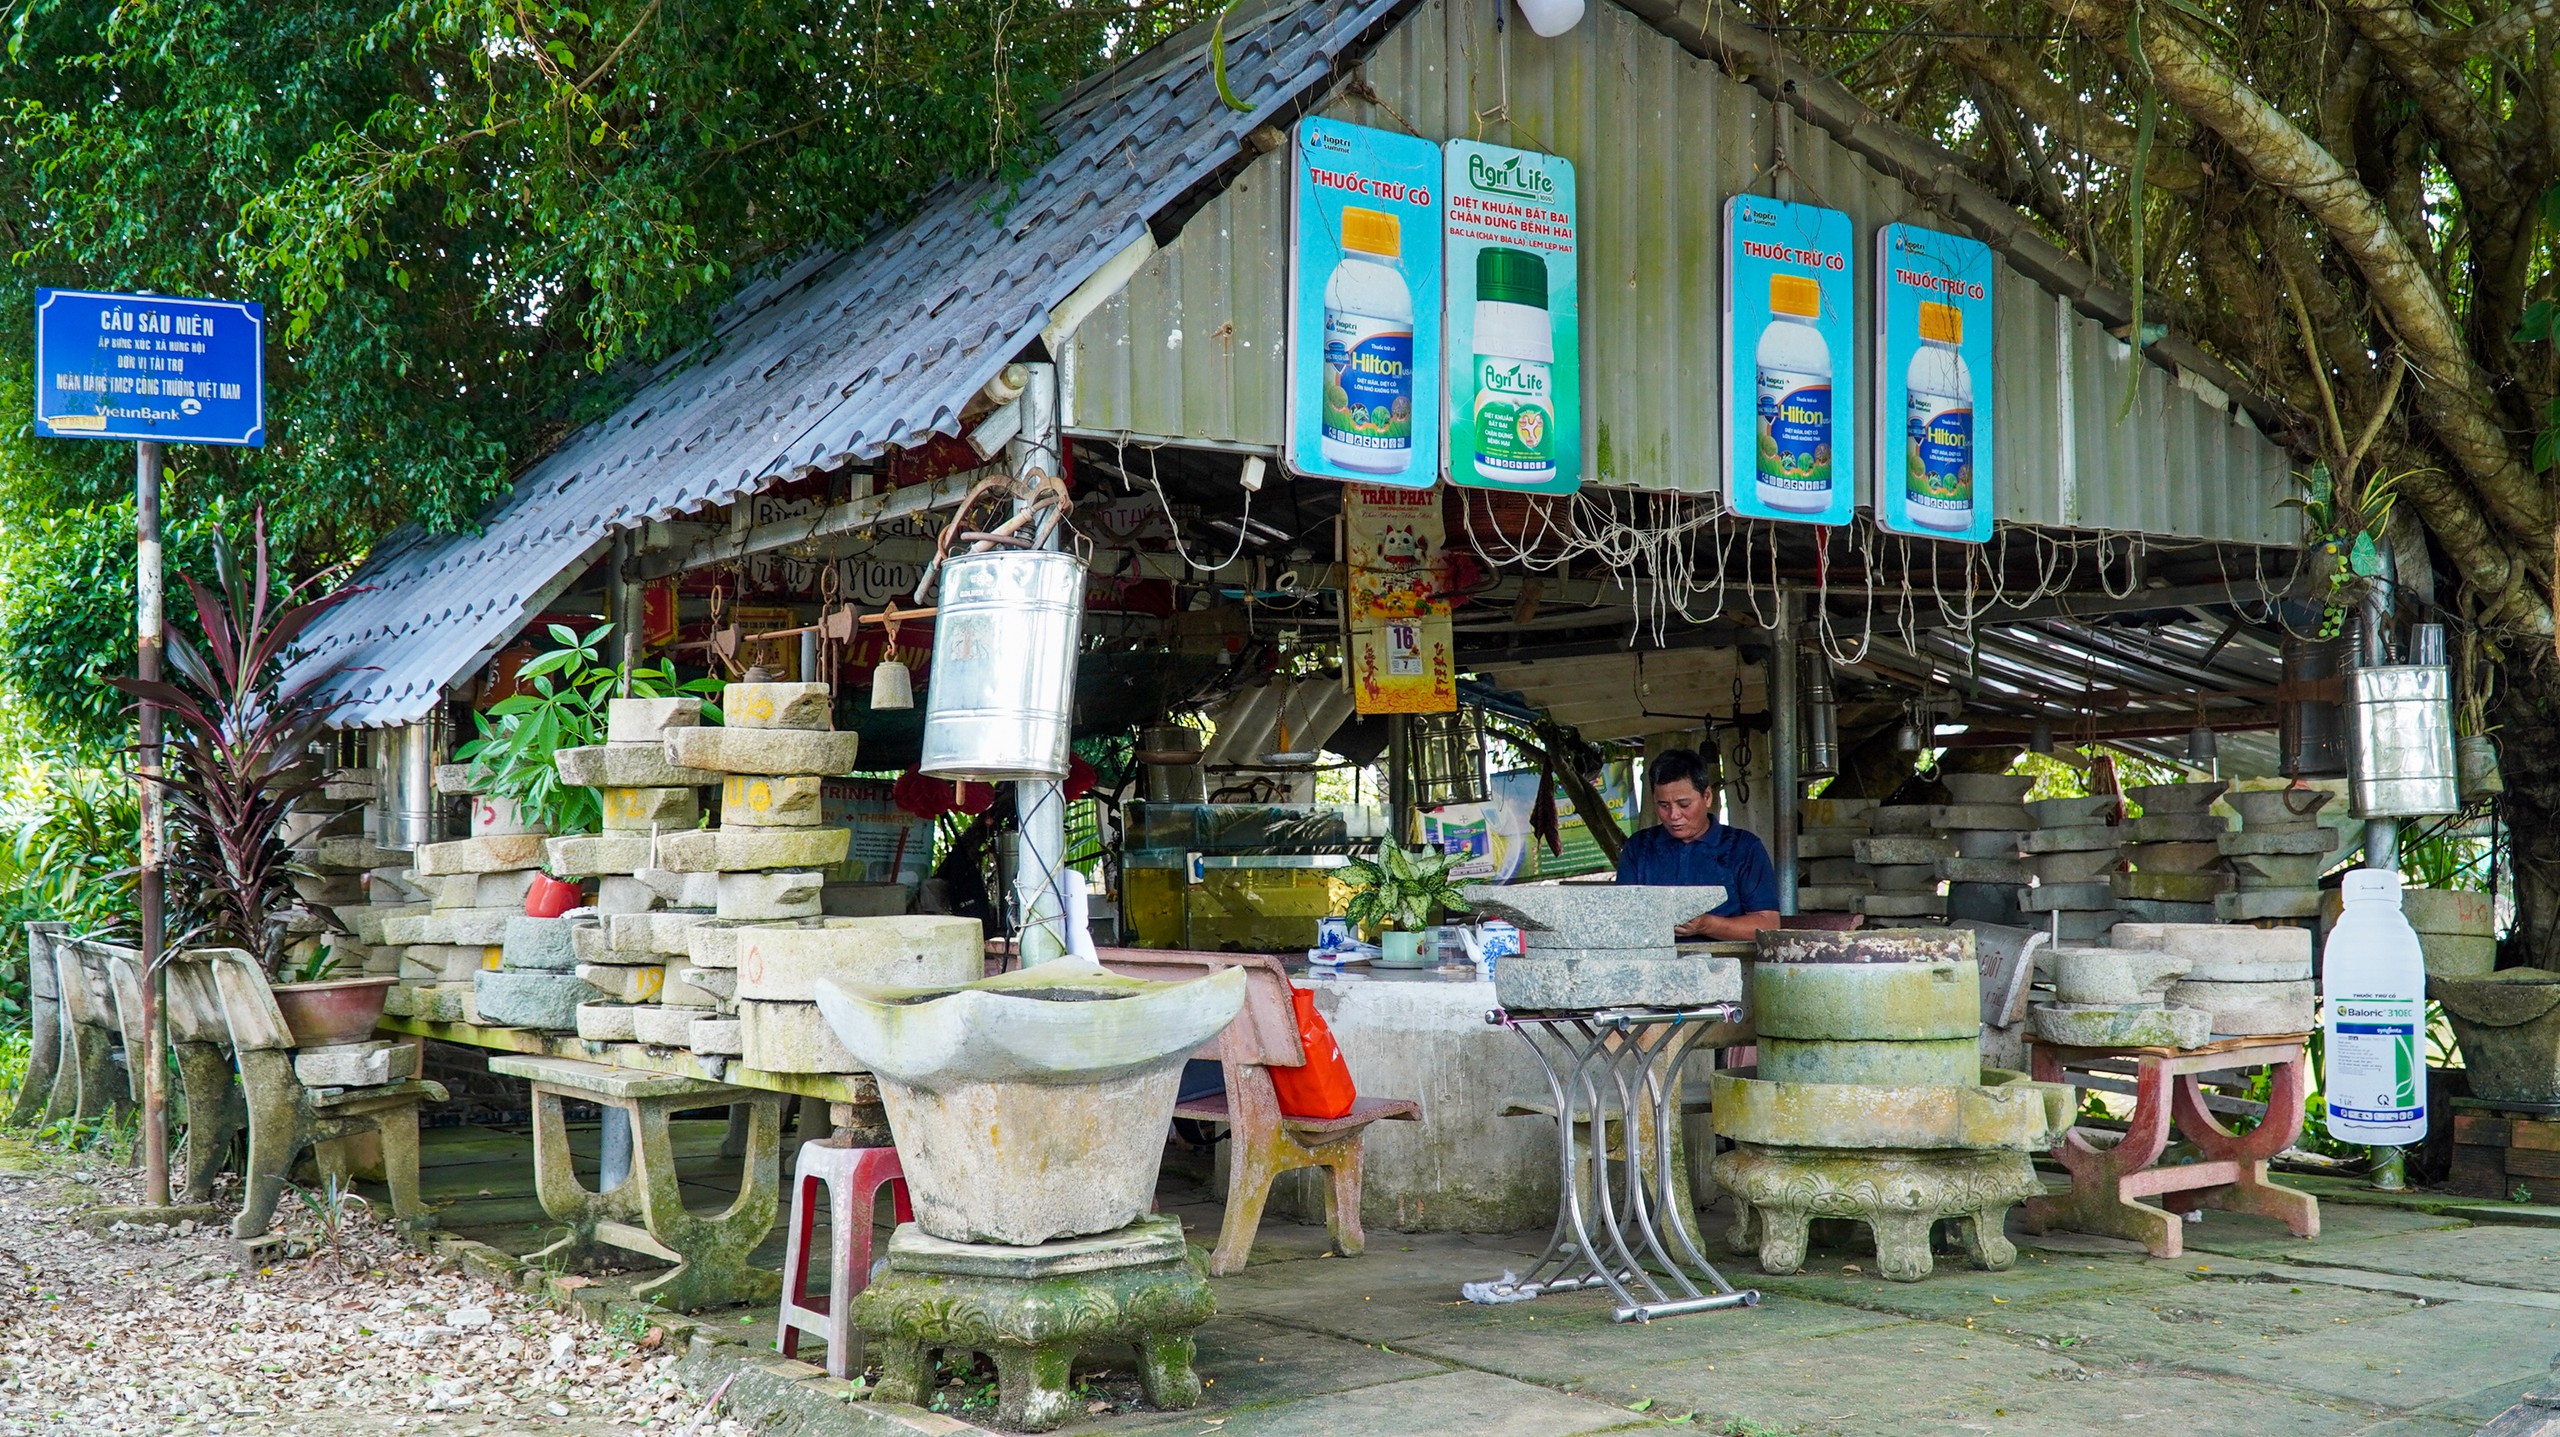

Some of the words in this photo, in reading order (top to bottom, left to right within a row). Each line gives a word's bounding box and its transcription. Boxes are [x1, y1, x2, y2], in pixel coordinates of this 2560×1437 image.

[1310, 168, 1369, 195] THUỐC
[1372, 181, 1406, 201] TRỪ
[1408, 186, 1431, 206] CỎ
[1517, 167, 1553, 193] Life
[1453, 196, 1478, 209] DIỆT
[1520, 218, 1550, 236] BỆNH
[1743, 241, 1792, 263] THUỐC
[1825, 252, 1844, 271] CỎ
[1896, 268, 1939, 291] THUỐC
[1968, 281, 1985, 300] CỎ
[101, 305, 133, 332] CẦU
[175, 313, 214, 337] NIÊN
[1351, 351, 1403, 376] Hilton
[1485, 364, 1511, 389] Agri
[1517, 373, 1543, 390] Life
[219, 382, 241, 400] NAM
[95, 404, 180, 421] VietinBank
[1780, 404, 1823, 425] Hilton
[1928, 426, 1966, 447] Hilton
[1393, 626, 1414, 650] 16
[2348, 1008, 2383, 1018] Baloric
[2387, 1008, 2412, 1018] 310EC
